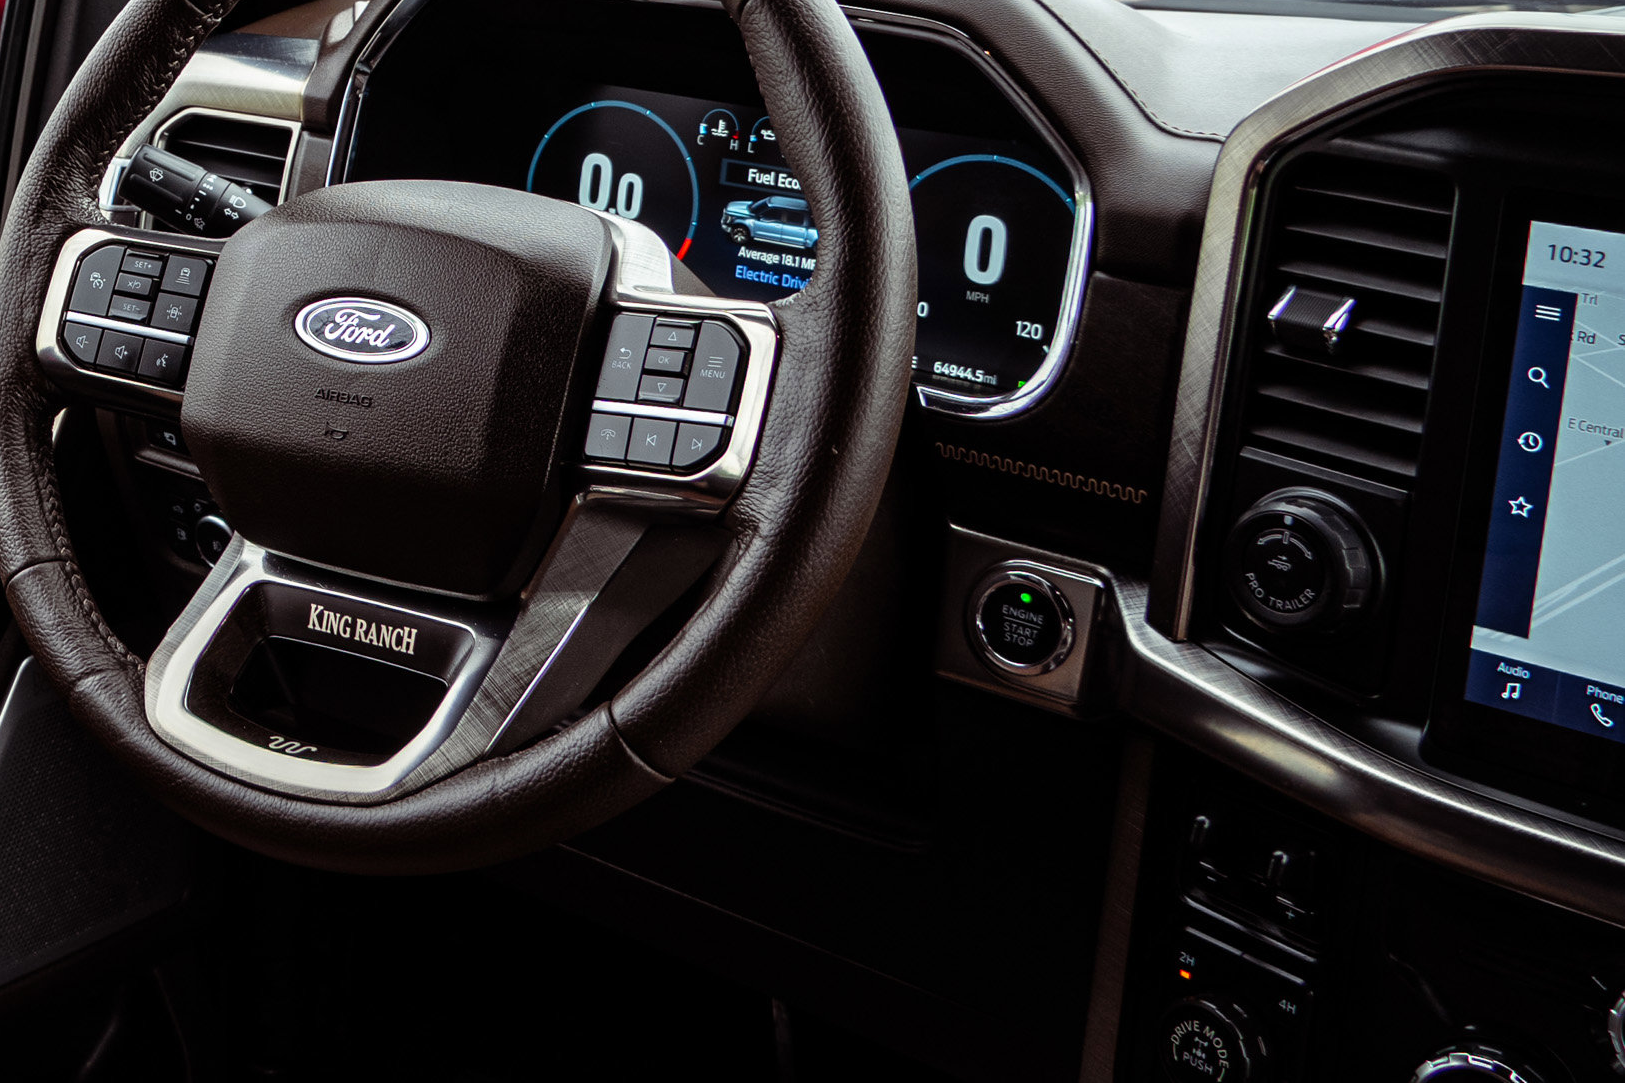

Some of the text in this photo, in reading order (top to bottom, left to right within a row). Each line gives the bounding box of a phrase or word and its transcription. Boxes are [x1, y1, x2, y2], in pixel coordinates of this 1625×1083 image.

[729, 139, 739, 151] H
[579, 152, 643, 220] 0.0
[747, 168, 802, 190] Fuel Eco
[737, 246, 780, 264] Average
[781, 252, 800, 267] 18.1
[963, 214, 1008, 285] 0
[1547, 243, 1606, 269] 10:32
[735, 265, 780, 286] Electric
[966, 290, 990, 304] MPH
[1581, 292, 1599, 307] Trl
[324, 308, 396, 348] Ford
[1015, 320, 1044, 341] 120
[1577, 329, 1597, 346] Rd
[611, 360, 632, 370] BACK
[658, 356, 670, 365] OK
[699, 369, 726, 379] MENU
[314, 387, 373, 408] AIRBAG
[1567, 417, 1624, 439] E Central
[1245, 572, 1316, 611] PRO TRAILER
[1002, 604, 1044, 625] ENGINE
[307, 603, 418, 655] KING RANCH
[1003, 621, 1039, 639] START
[1004, 632, 1035, 647] STOP
[1496, 661, 1531, 679] Audio
[1585, 684, 1625, 705] Phone
[1179, 951, 1195, 967] 2H
[1278, 999, 1297, 1015] 4H
[1170, 1020, 1230, 1069] DRIVE MODE
[1182, 1051, 1214, 1076] PUSH
